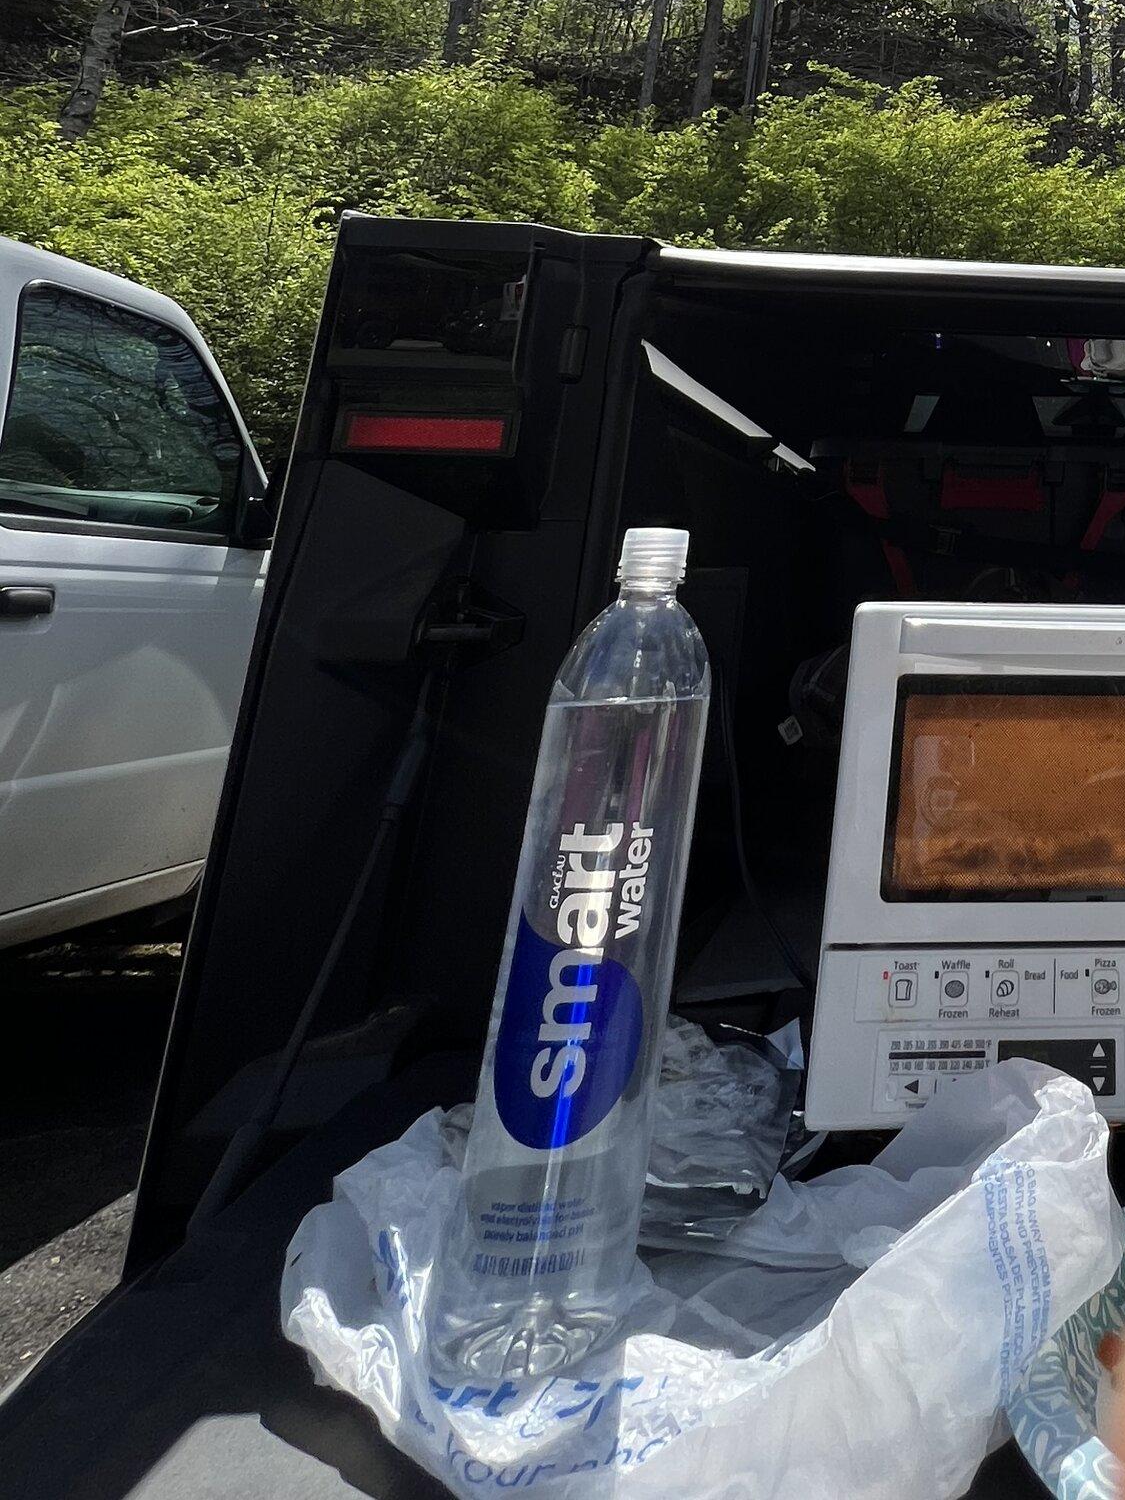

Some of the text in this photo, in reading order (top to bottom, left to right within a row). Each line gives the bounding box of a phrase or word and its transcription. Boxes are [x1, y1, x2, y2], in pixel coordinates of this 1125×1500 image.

[549, 854, 567, 910] GLACÉAU
[614, 821, 654, 940] water
[530, 822, 624, 1099] smart
[893, 960, 918, 971] Toast
[941, 959, 971, 970] Waffle
[998, 958, 1015, 969] Roll
[1094, 958, 1117, 968] Pizza
[1024, 970, 1046, 981] Bread
[1060, 970, 1079, 980] Food
[938, 1008, 969, 1019] Frozen
[988, 1007, 1020, 1018] Reheat
[1091, 1005, 1121, 1016] Frozen
[998, 1188, 1008, 1222] ESTA
[985, 1182, 1009, 1281] COMPONENTES
[999, 1221, 1017, 1266] BOLSA
[1028, 1209, 1044, 1243] AWAY
[1036, 1247, 1052, 1287] FROM
[1015, 1213, 1028, 1239] AND
[1022, 1240, 1041, 1303] PREVENT
[1010, 1264, 1023, 1287] DE
